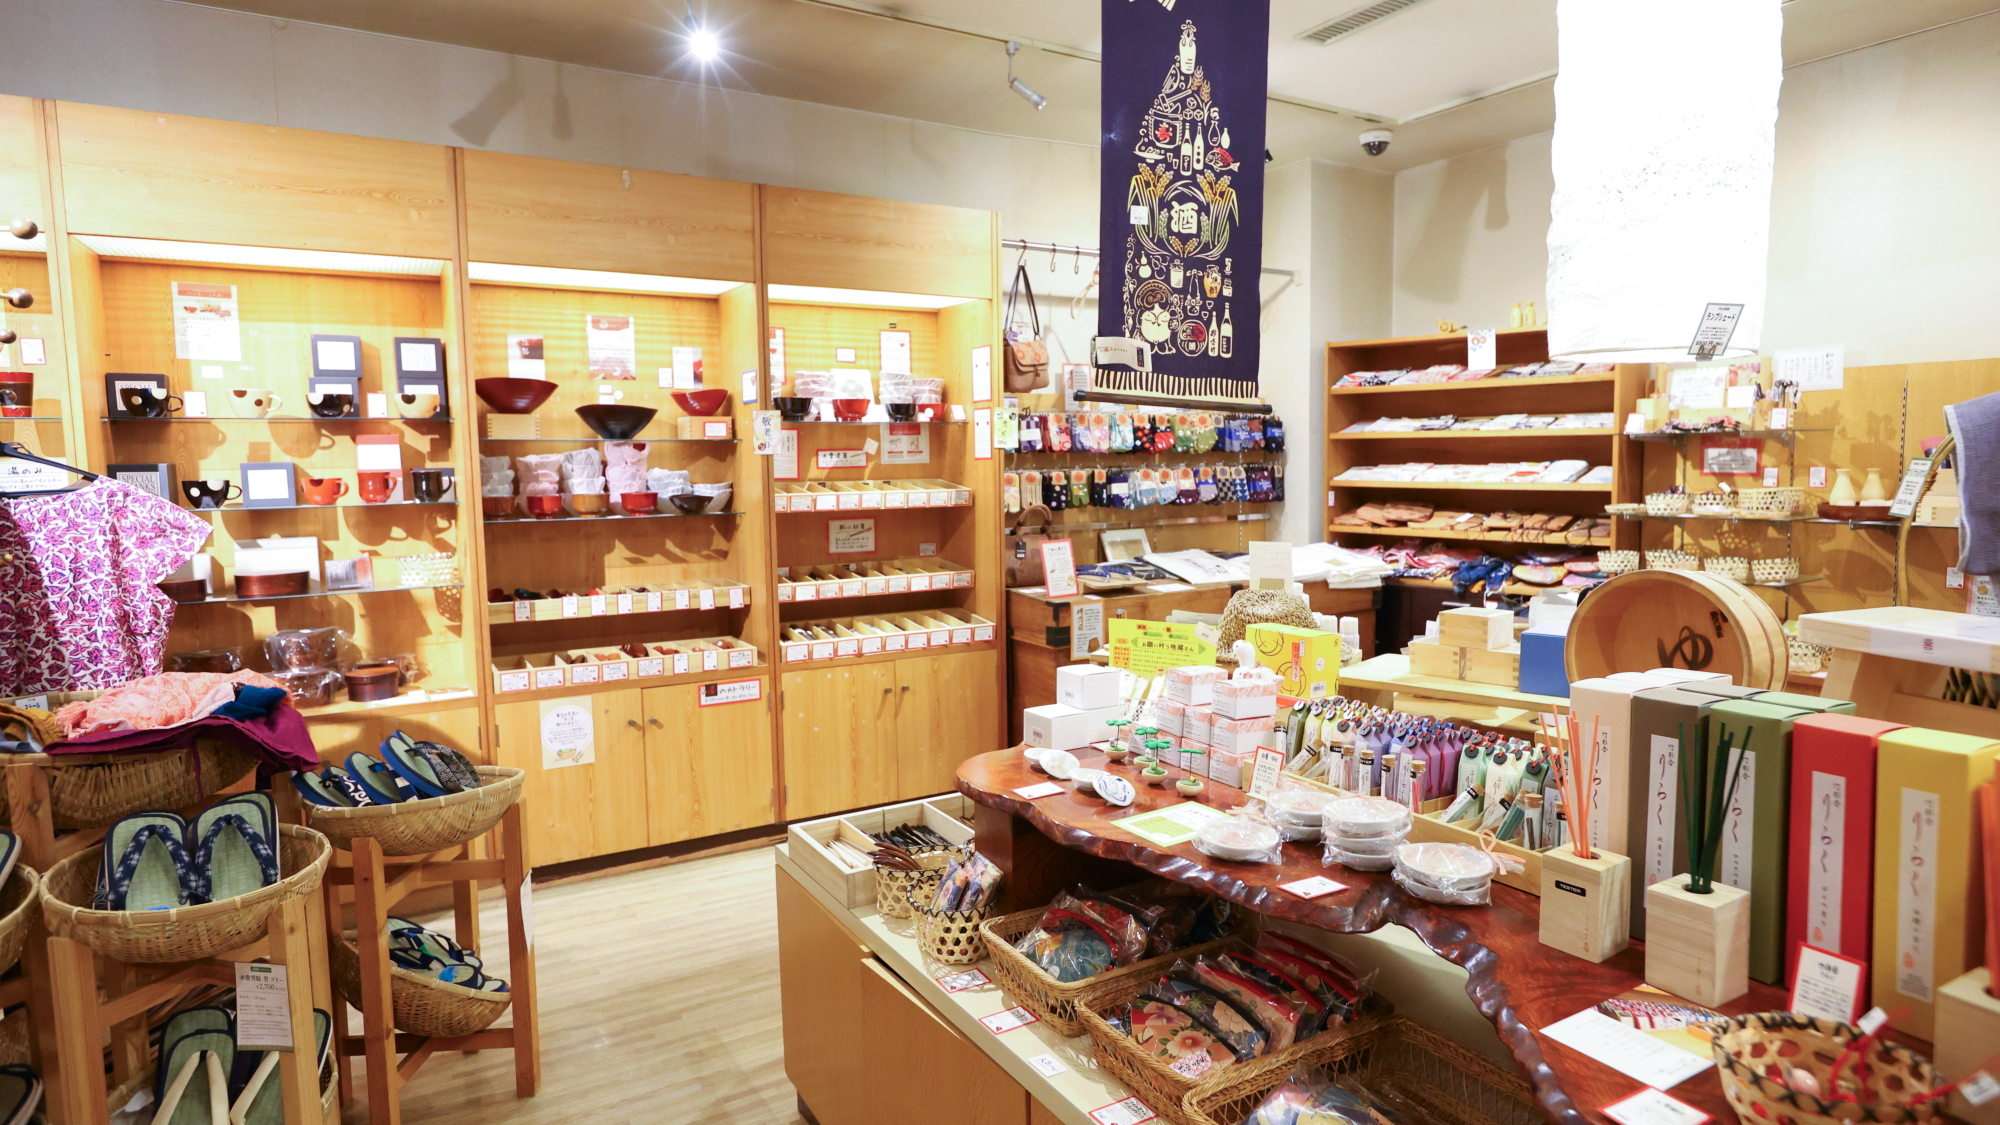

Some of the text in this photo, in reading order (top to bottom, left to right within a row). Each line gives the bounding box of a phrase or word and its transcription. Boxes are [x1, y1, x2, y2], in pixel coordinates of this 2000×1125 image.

[1170, 201, 1199, 234] 酒
[1706, 312, 1736, 322] ランプシェード
[8, 466, 42, 475] 湯のみ
[121, 474, 155, 483] SPECIAL
[1142, 641, 1194, 652] お願い叶う地蔵さん
[1656, 625, 1713, 670] ゆ
[1657, 753, 1667, 826] りらく
[1820, 793, 1833, 873] りらく
[1910, 811, 1924, 897] りらく
[1560, 884, 1581, 893] TESTER
